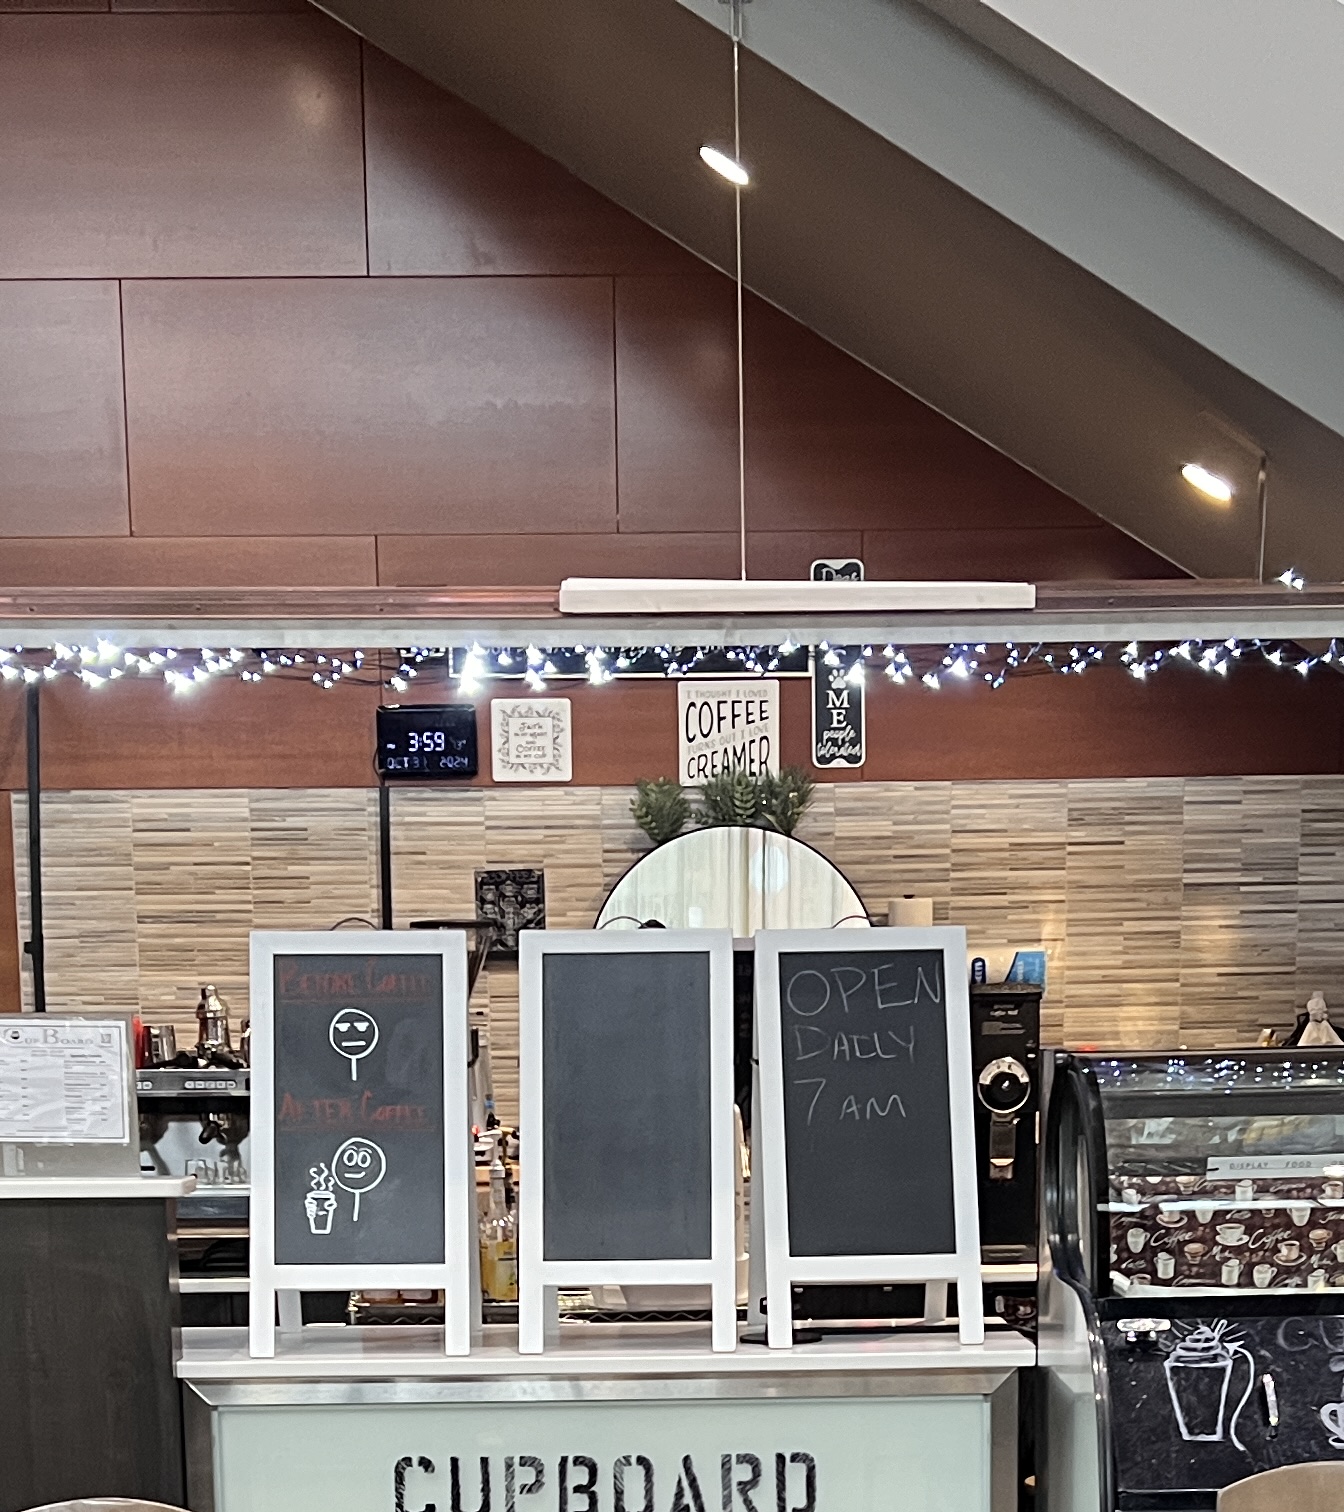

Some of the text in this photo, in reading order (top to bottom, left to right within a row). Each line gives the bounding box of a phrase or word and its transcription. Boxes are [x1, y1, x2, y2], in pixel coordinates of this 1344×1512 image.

[696, 690, 731, 698] THOUGHT
[743, 690, 768, 698] LOVED
[685, 700, 769, 743] COFFEE
[408, 731, 445, 752] 3:59
[687, 739, 716, 755] TURNS
[719, 733, 736, 745] OUT
[687, 736, 770, 779] CREAMER
[787, 959, 941, 1016] OPEN
[792, 1024, 915, 1064] DAILY
[793, 1078, 906, 1127] 7 AM
[1150, 1229, 1196, 1249] Coffee
[1248, 1227, 1293, 1250] Coffee
